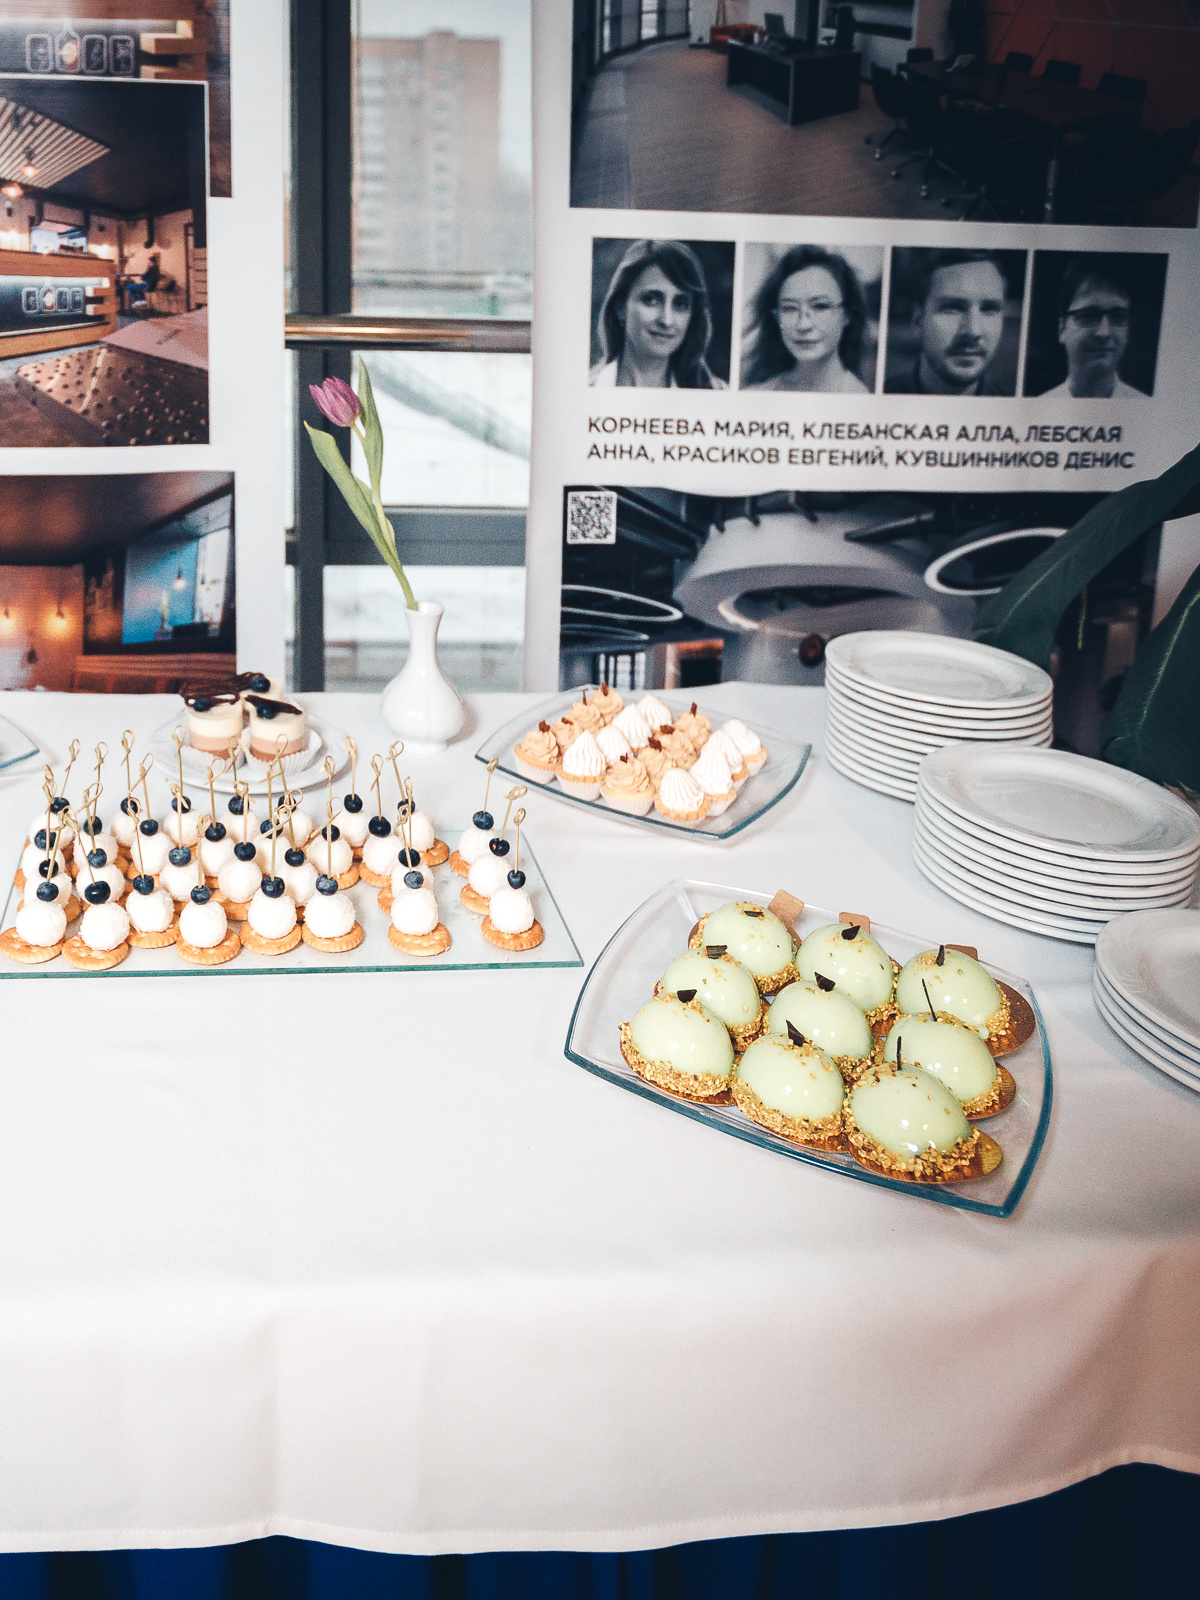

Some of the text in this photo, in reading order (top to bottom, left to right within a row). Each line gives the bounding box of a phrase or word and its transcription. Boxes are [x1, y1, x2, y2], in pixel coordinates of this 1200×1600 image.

[587, 416, 1123, 445] КОРНЕЕВА МАРИЯ, КЛЕБАНСКАЯ АЛЛА, ЛЕБСКАЯ
[587, 443, 1136, 471] АННА, КРАСИКОВ ЕВГЕНИЙ, КУВШИННИКОВ ДЕНИС
